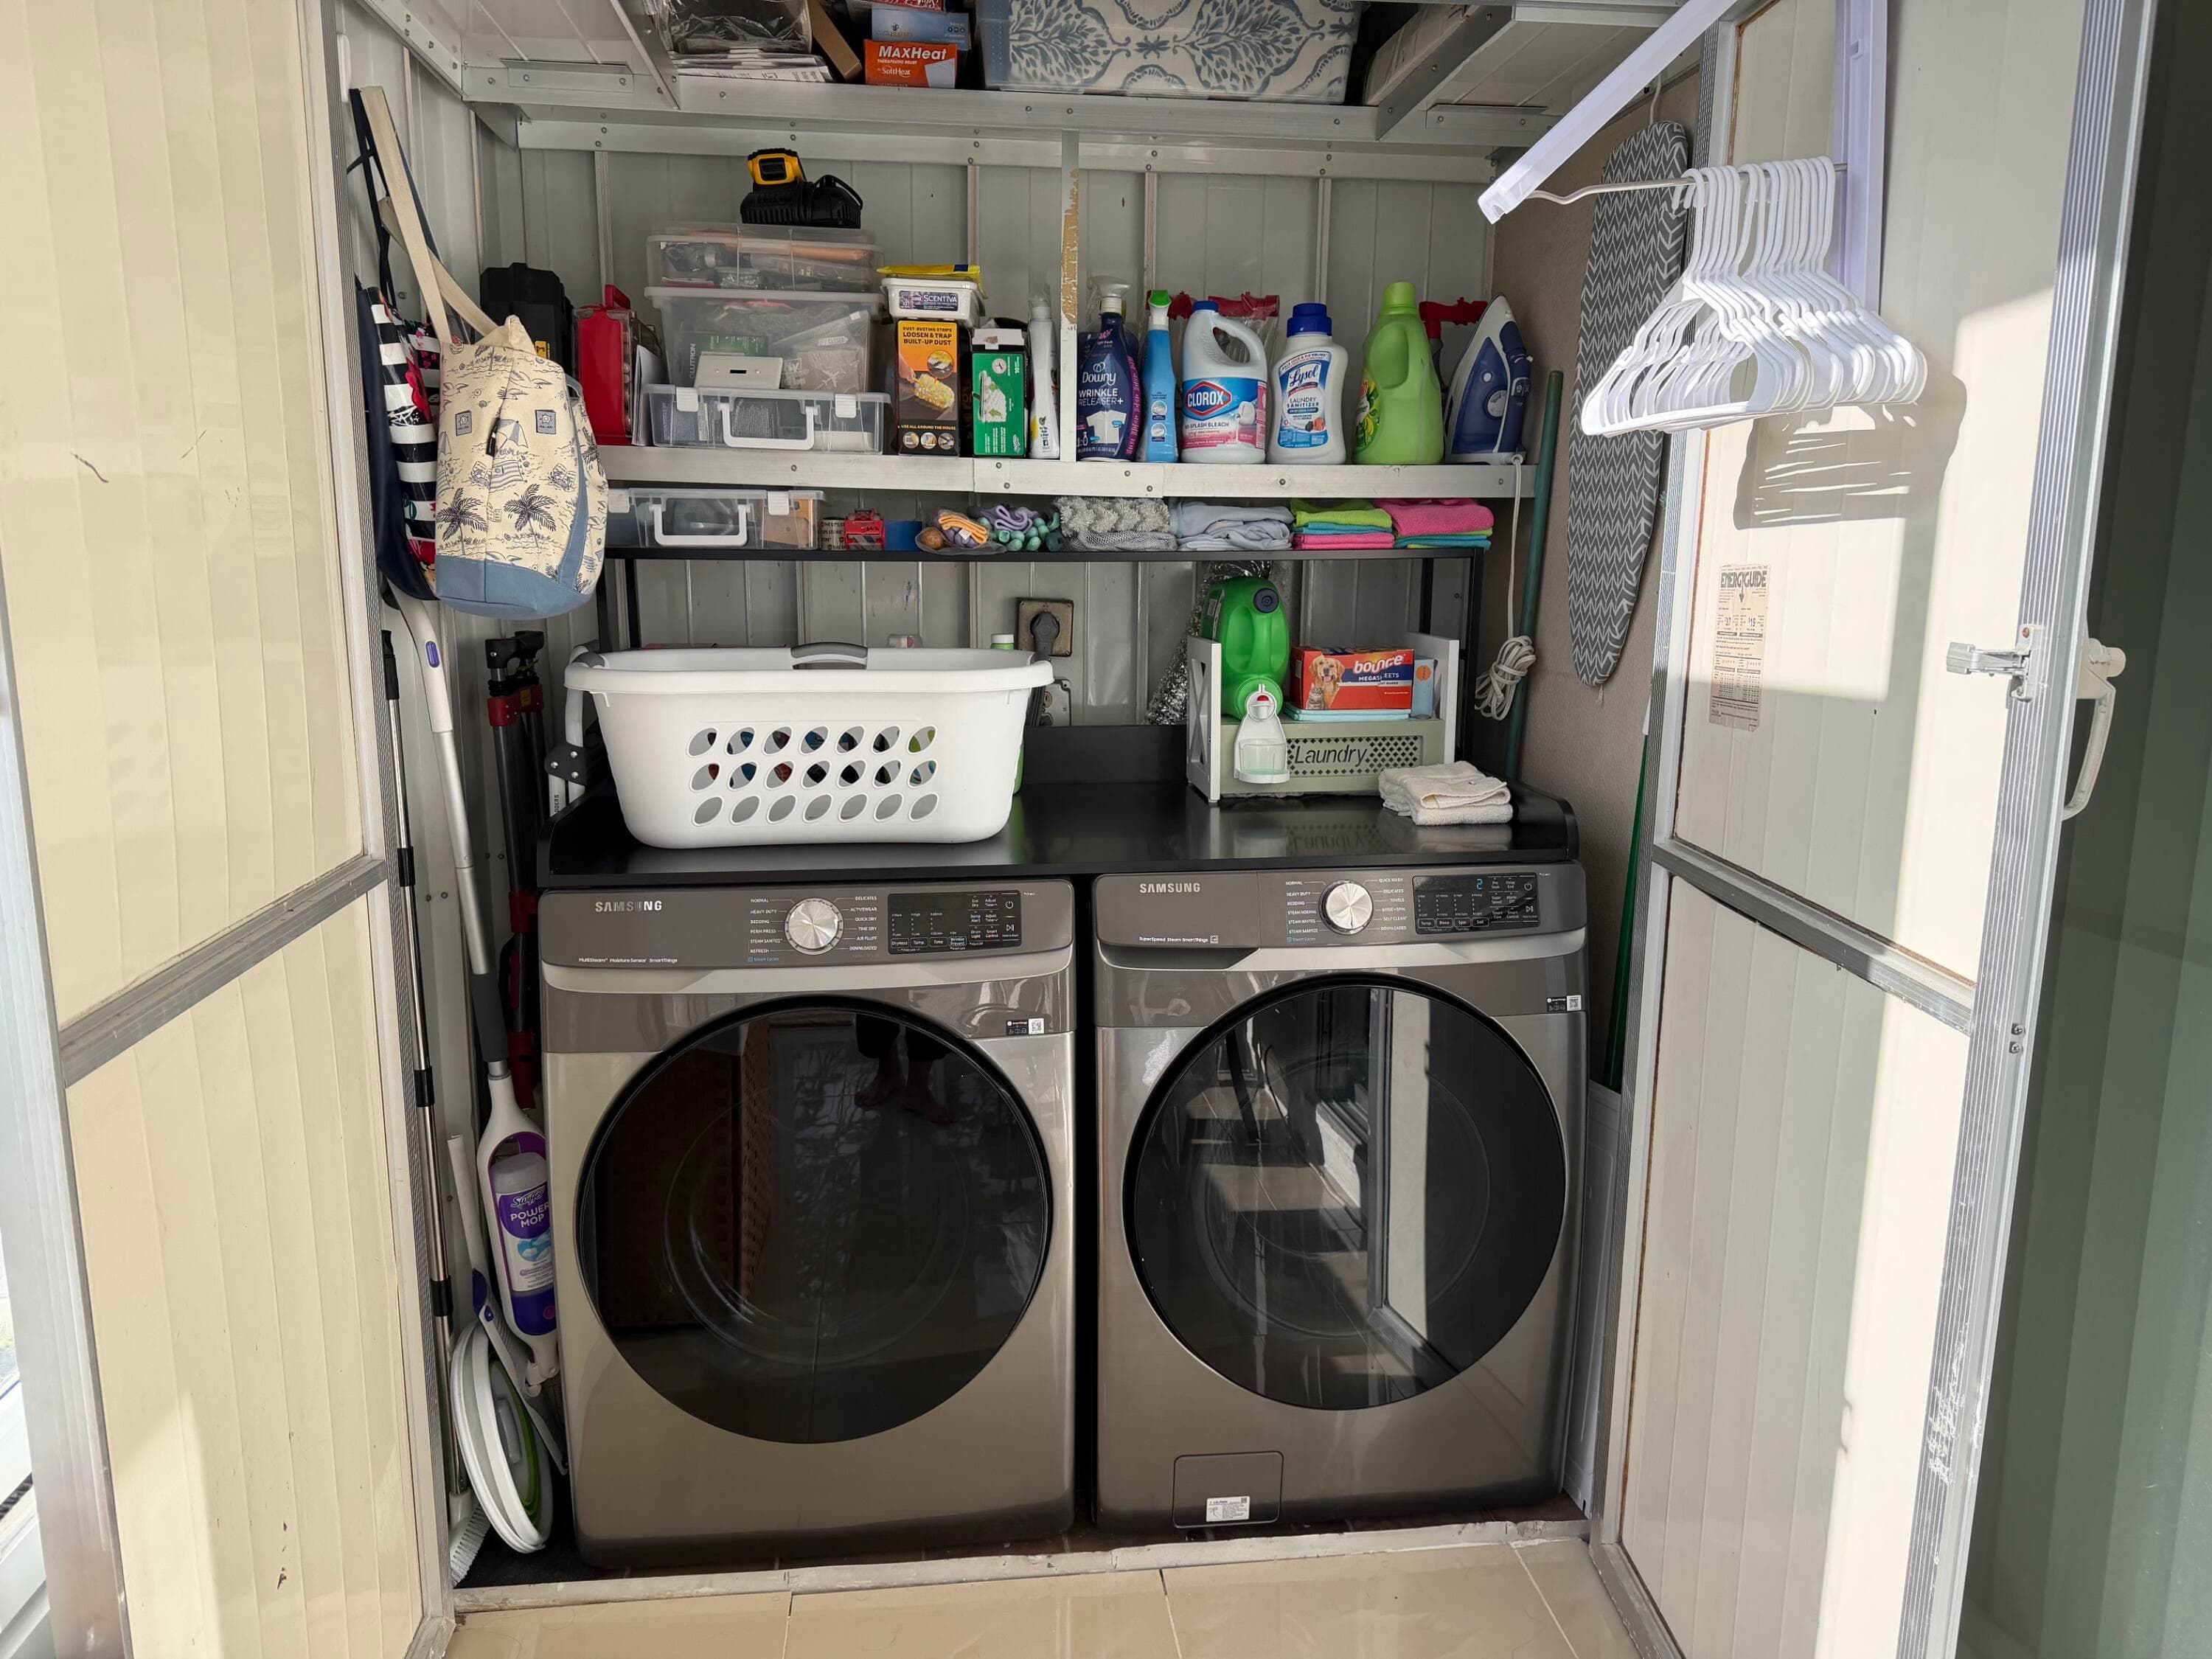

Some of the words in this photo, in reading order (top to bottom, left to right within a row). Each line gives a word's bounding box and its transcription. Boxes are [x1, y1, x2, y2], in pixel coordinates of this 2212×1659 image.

[879, 46, 947, 60] MAXHeat
[1082, 372, 1116, 386] Downy
[1290, 365, 1319, 386] Lysol
[1079, 388, 1118, 397] WRINKLE
[1079, 397, 1124, 406] RELEASER+
[1187, 392, 1224, 408] CLOROX
[1721, 571, 1767, 588] ENERGYGUIDE
[1354, 655, 1404, 674] bounce
[1294, 745, 1368, 767] Laundry
[1140, 883, 1200, 894] SAMSUNG
[1476, 878, 1483, 890] 2
[595, 900, 662, 912] SAMSUNG
[511, 1189, 544, 1208] Swiffer
[510, 1202, 549, 1222] POWER
[521, 1214, 544, 1228] MOP
